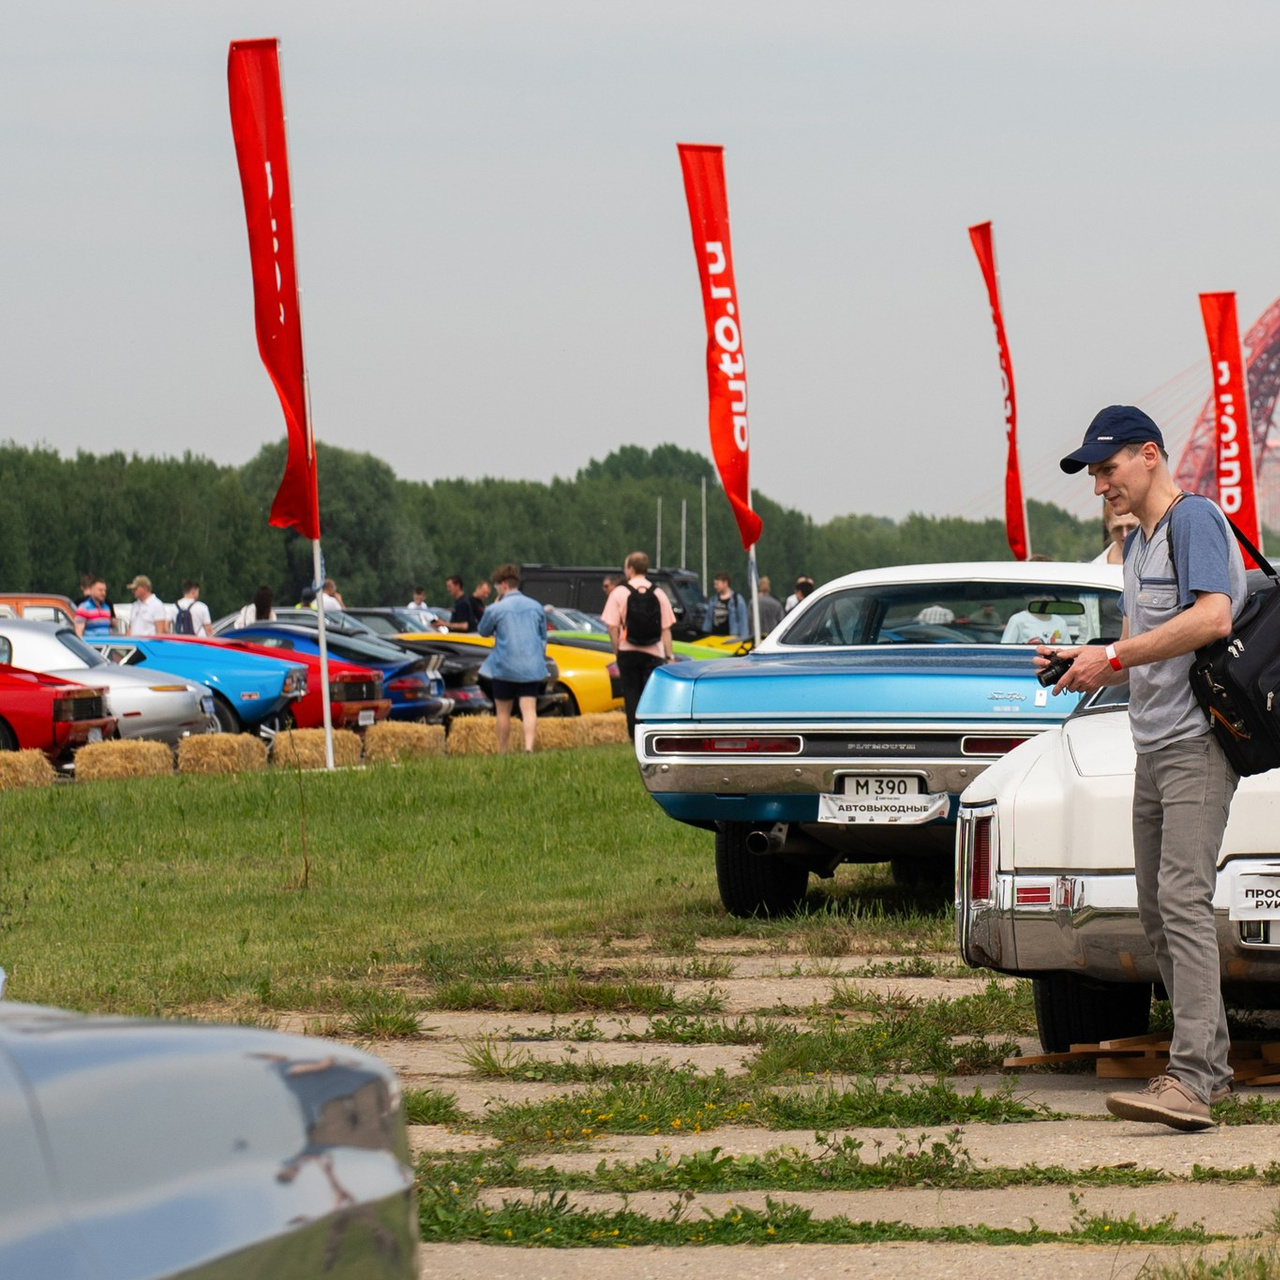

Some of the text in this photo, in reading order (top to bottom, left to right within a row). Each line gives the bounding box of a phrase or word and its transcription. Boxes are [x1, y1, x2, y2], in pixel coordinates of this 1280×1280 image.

[706, 241, 749, 452] auto.ru
[874, 779, 908, 795] 390
[837, 804, 930, 813] АВТОВЫХОДНЫЕ
